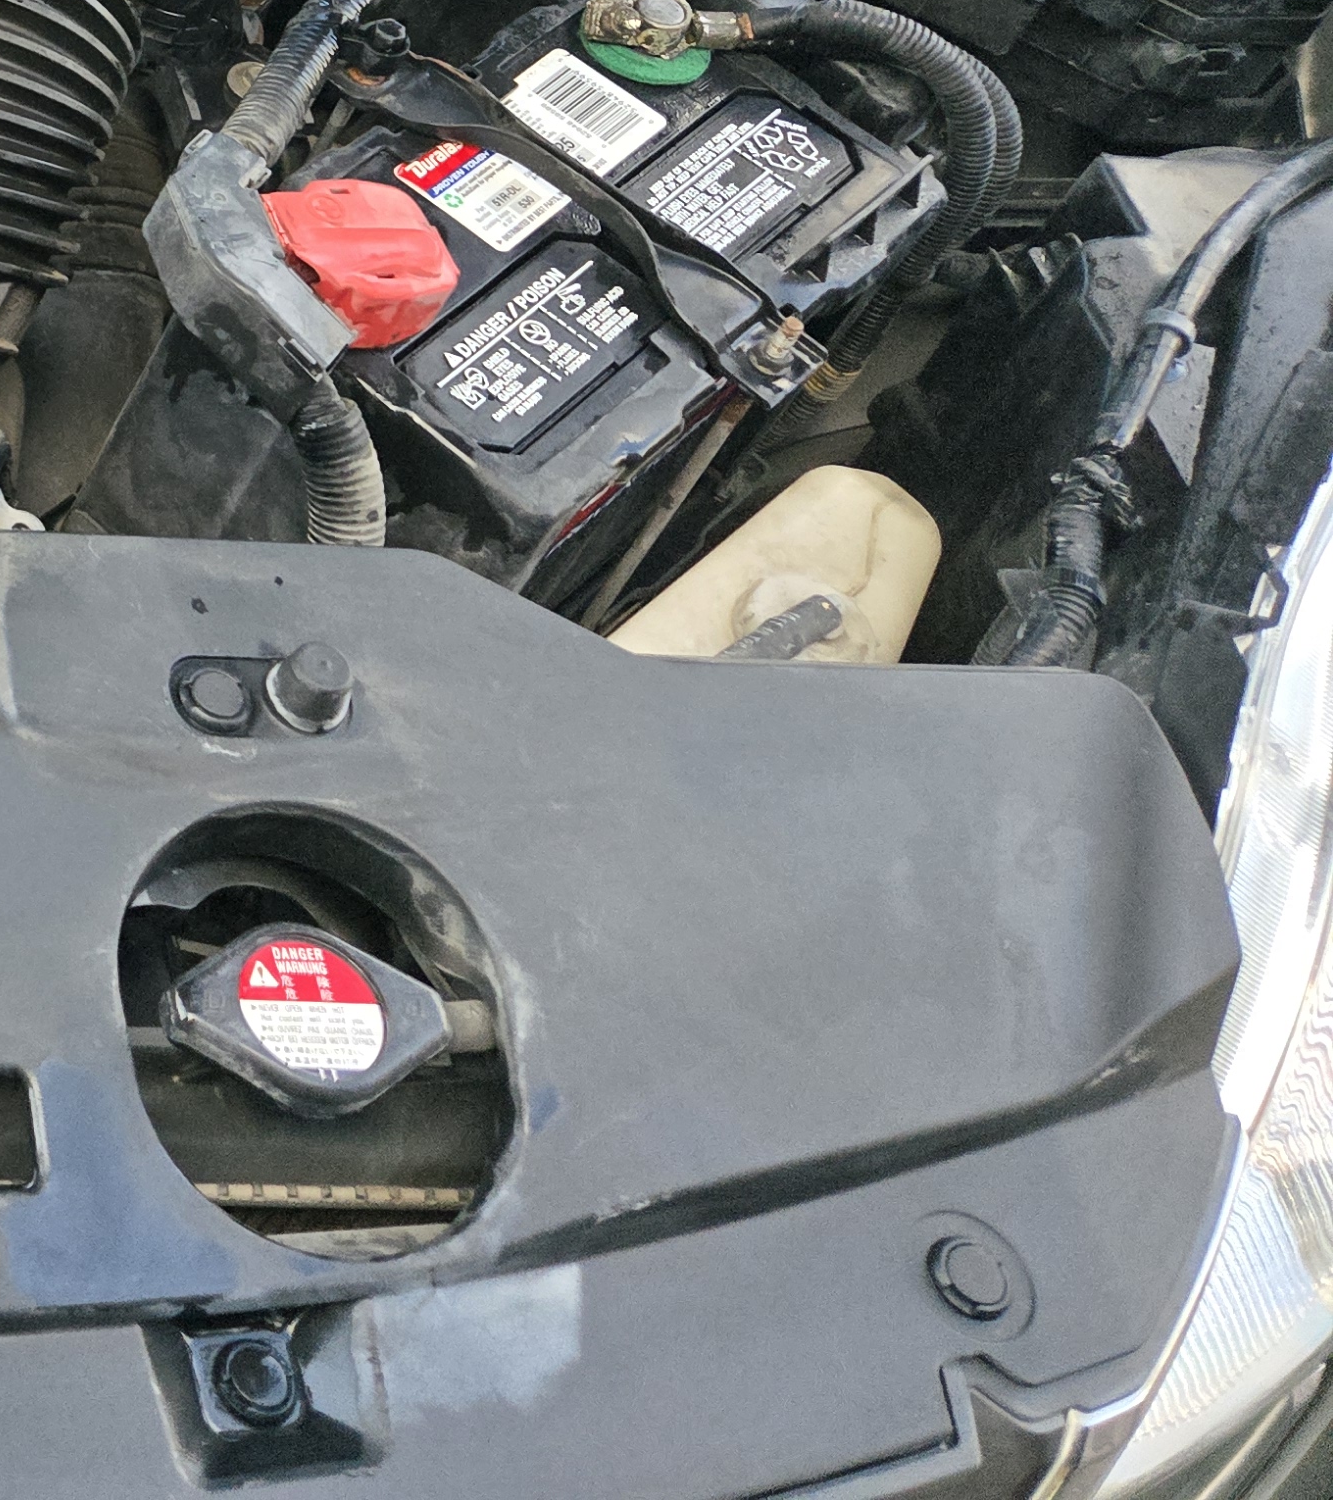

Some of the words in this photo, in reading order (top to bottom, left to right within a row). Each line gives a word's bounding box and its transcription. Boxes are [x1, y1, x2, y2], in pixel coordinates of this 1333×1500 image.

[404, 143, 462, 178] Duralas
[432, 168, 465, 195] PROVEN
[462, 150, 489, 171] TOUGH
[491, 185, 522, 207] 51R-DL
[704, 195, 724, 212] HELP
[719, 183, 740, 200] FAST
[706, 181, 724, 195] GET
[517, 195, 535, 209] 530
[660, 199, 684, 219] FLUSH
[678, 187, 700, 203] EYES
[454, 311, 512, 357] DANGER
[507, 301, 518, 319] /
[513, 267, 565, 309] POISON
[542, 339, 559, 352] NO
[487, 363, 526, 395] EXPLOSIVE
[497, 380, 523, 402] GASES
[271, 946, 324, 961] DANGER
[276, 961, 328, 975] WARNUNG
